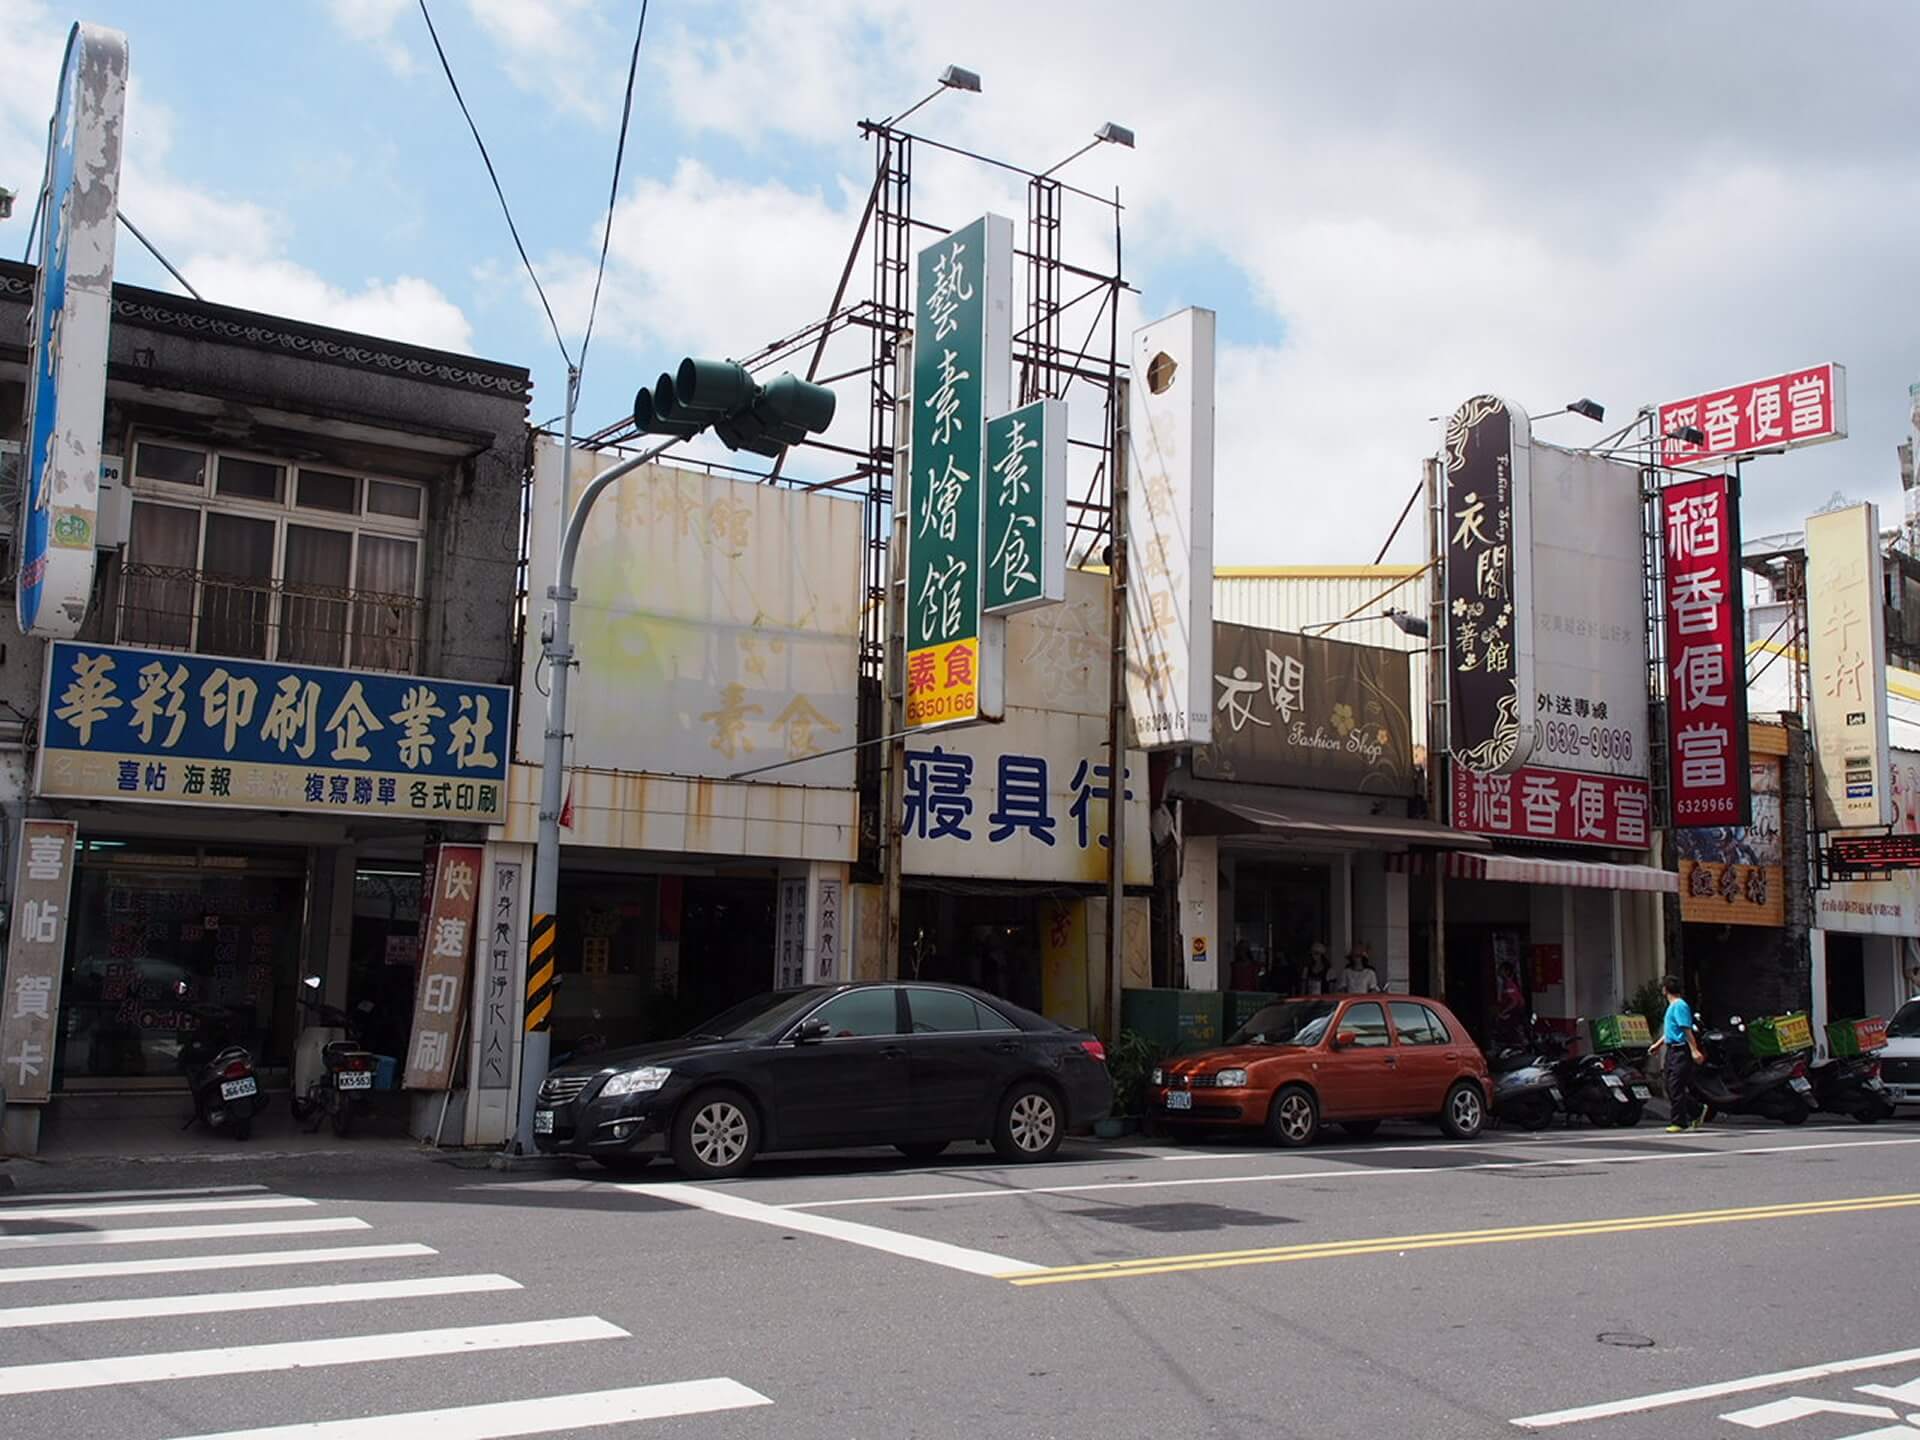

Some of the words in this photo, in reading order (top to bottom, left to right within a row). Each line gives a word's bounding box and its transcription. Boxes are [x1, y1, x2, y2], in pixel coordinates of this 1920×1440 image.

[918, 240, 974, 643] 藝素燴館
[1664, 375, 1825, 461] 稻香便當
[990, 418, 1039, 596] 素食
[1452, 492, 1508, 599] 衣閣
[908, 644, 973, 697] 素食
[1668, 488, 1728, 788] 稻香便當
[54, 651, 499, 770] 華彩印刷企業社
[908, 692, 975, 719] 6350166
[1214, 650, 1304, 731] 衣閣
[1537, 693, 1608, 720] 外送專線
[117, 760, 167, 791] 喜帖
[182, 765, 232, 796] 海報
[304, 773, 396, 806] 複寫聯單
[409, 781, 498, 813] 各式印刷
[1288, 722, 1341, 751] Fashion
[1346, 728, 1383, 765] Shop
[901, 745, 1133, 848] 寢具行
[1472, 771, 1648, 843] 稻香便當
[1678, 798, 1734, 814] 6329966
[7, 835, 65, 1086] 喜帖賀卡
[413, 860, 472, 1073] 快速印刷
